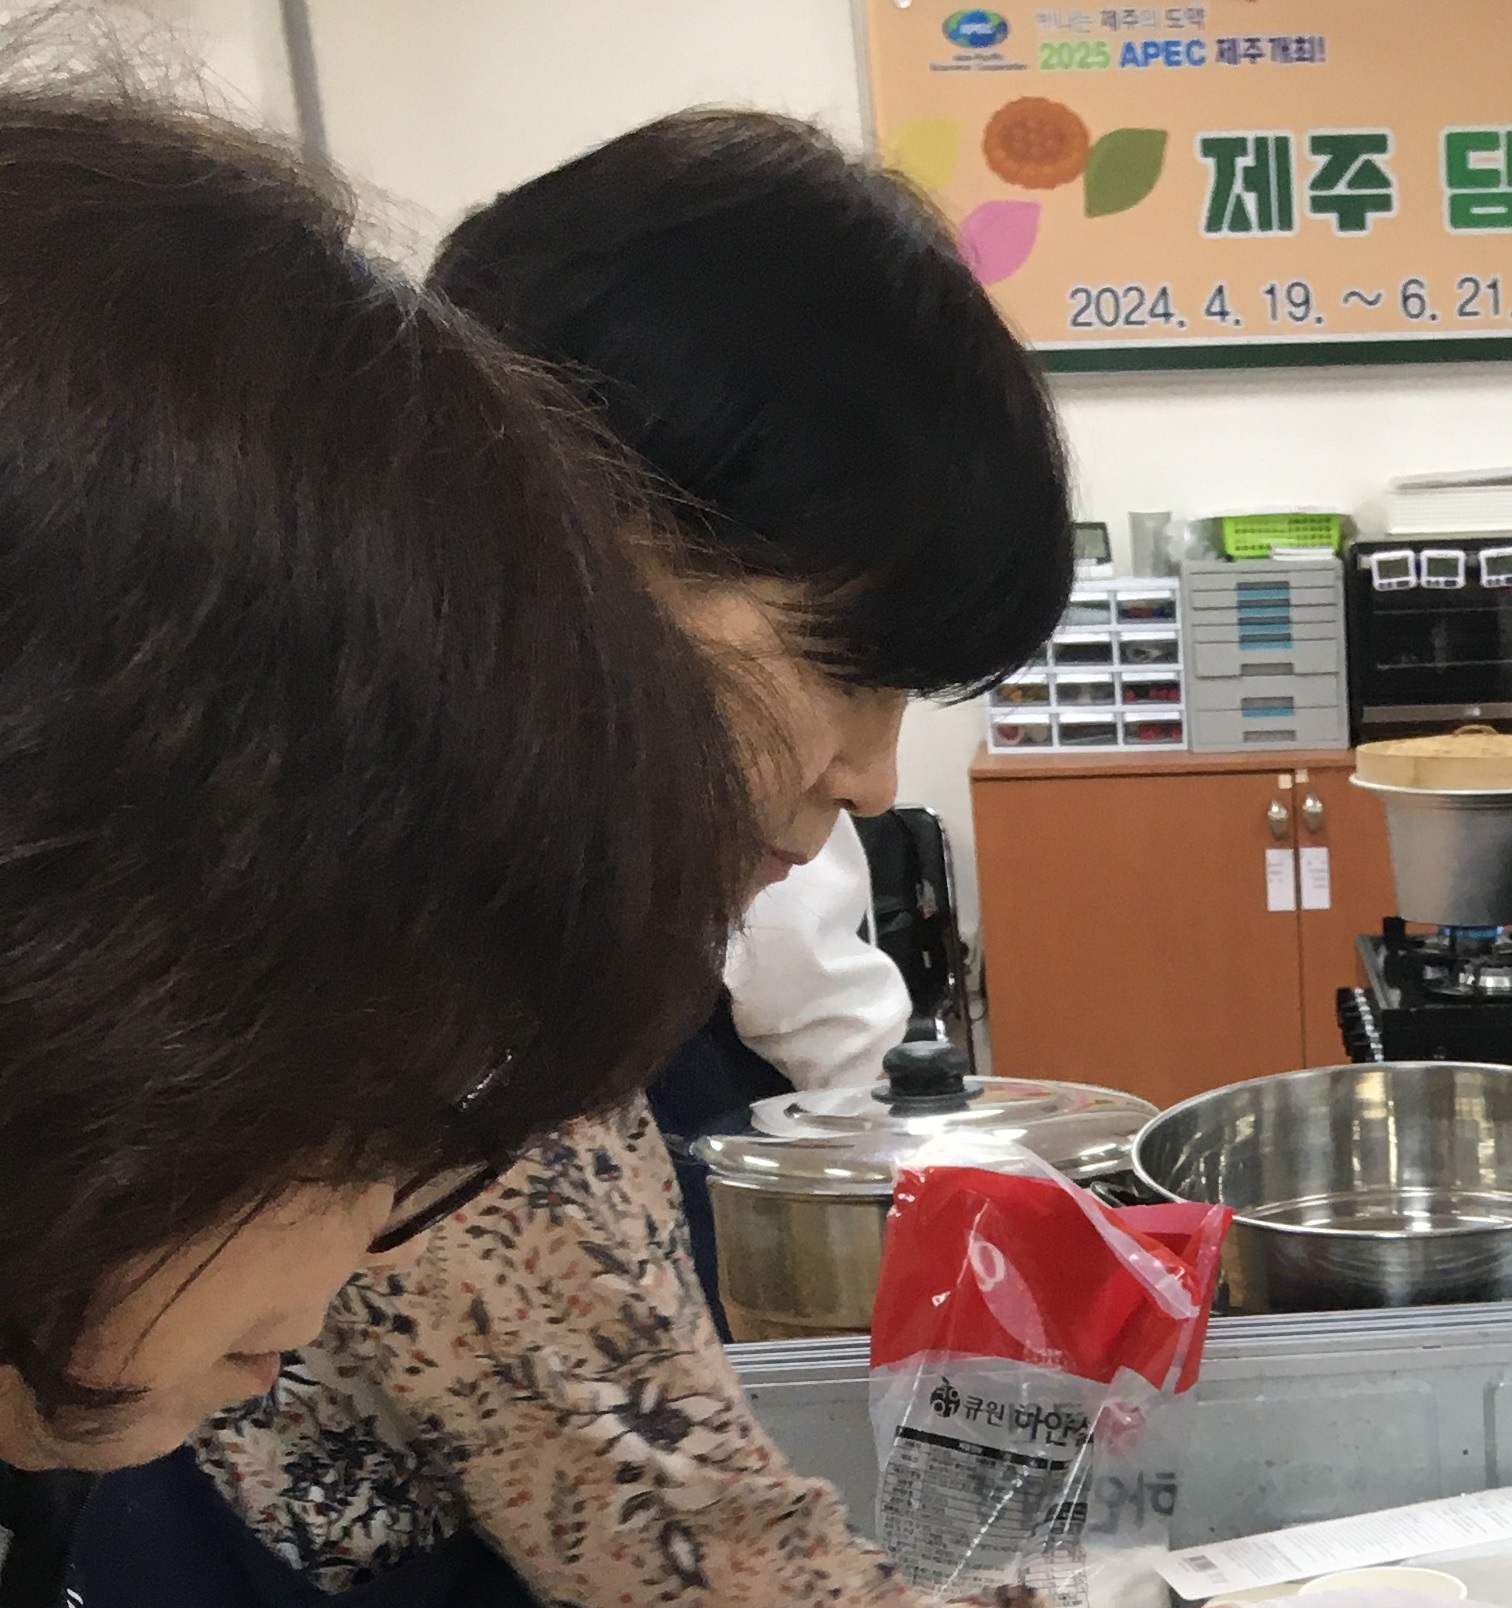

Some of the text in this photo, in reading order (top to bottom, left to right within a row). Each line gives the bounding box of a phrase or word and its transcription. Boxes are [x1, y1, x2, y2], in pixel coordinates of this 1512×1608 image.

[1038, 39, 1112, 71] 2025
[1118, 38, 1207, 70] APEC
[1198, 129, 1397, 237] 제주
[1069, 285, 1187, 329] 2024.
[1204, 284, 1242, 326] 4.
[1264, 281, 1325, 325] 19.
[1401, 278, 1439, 322] 6.
[964, 1395, 1006, 1428] 큐원
